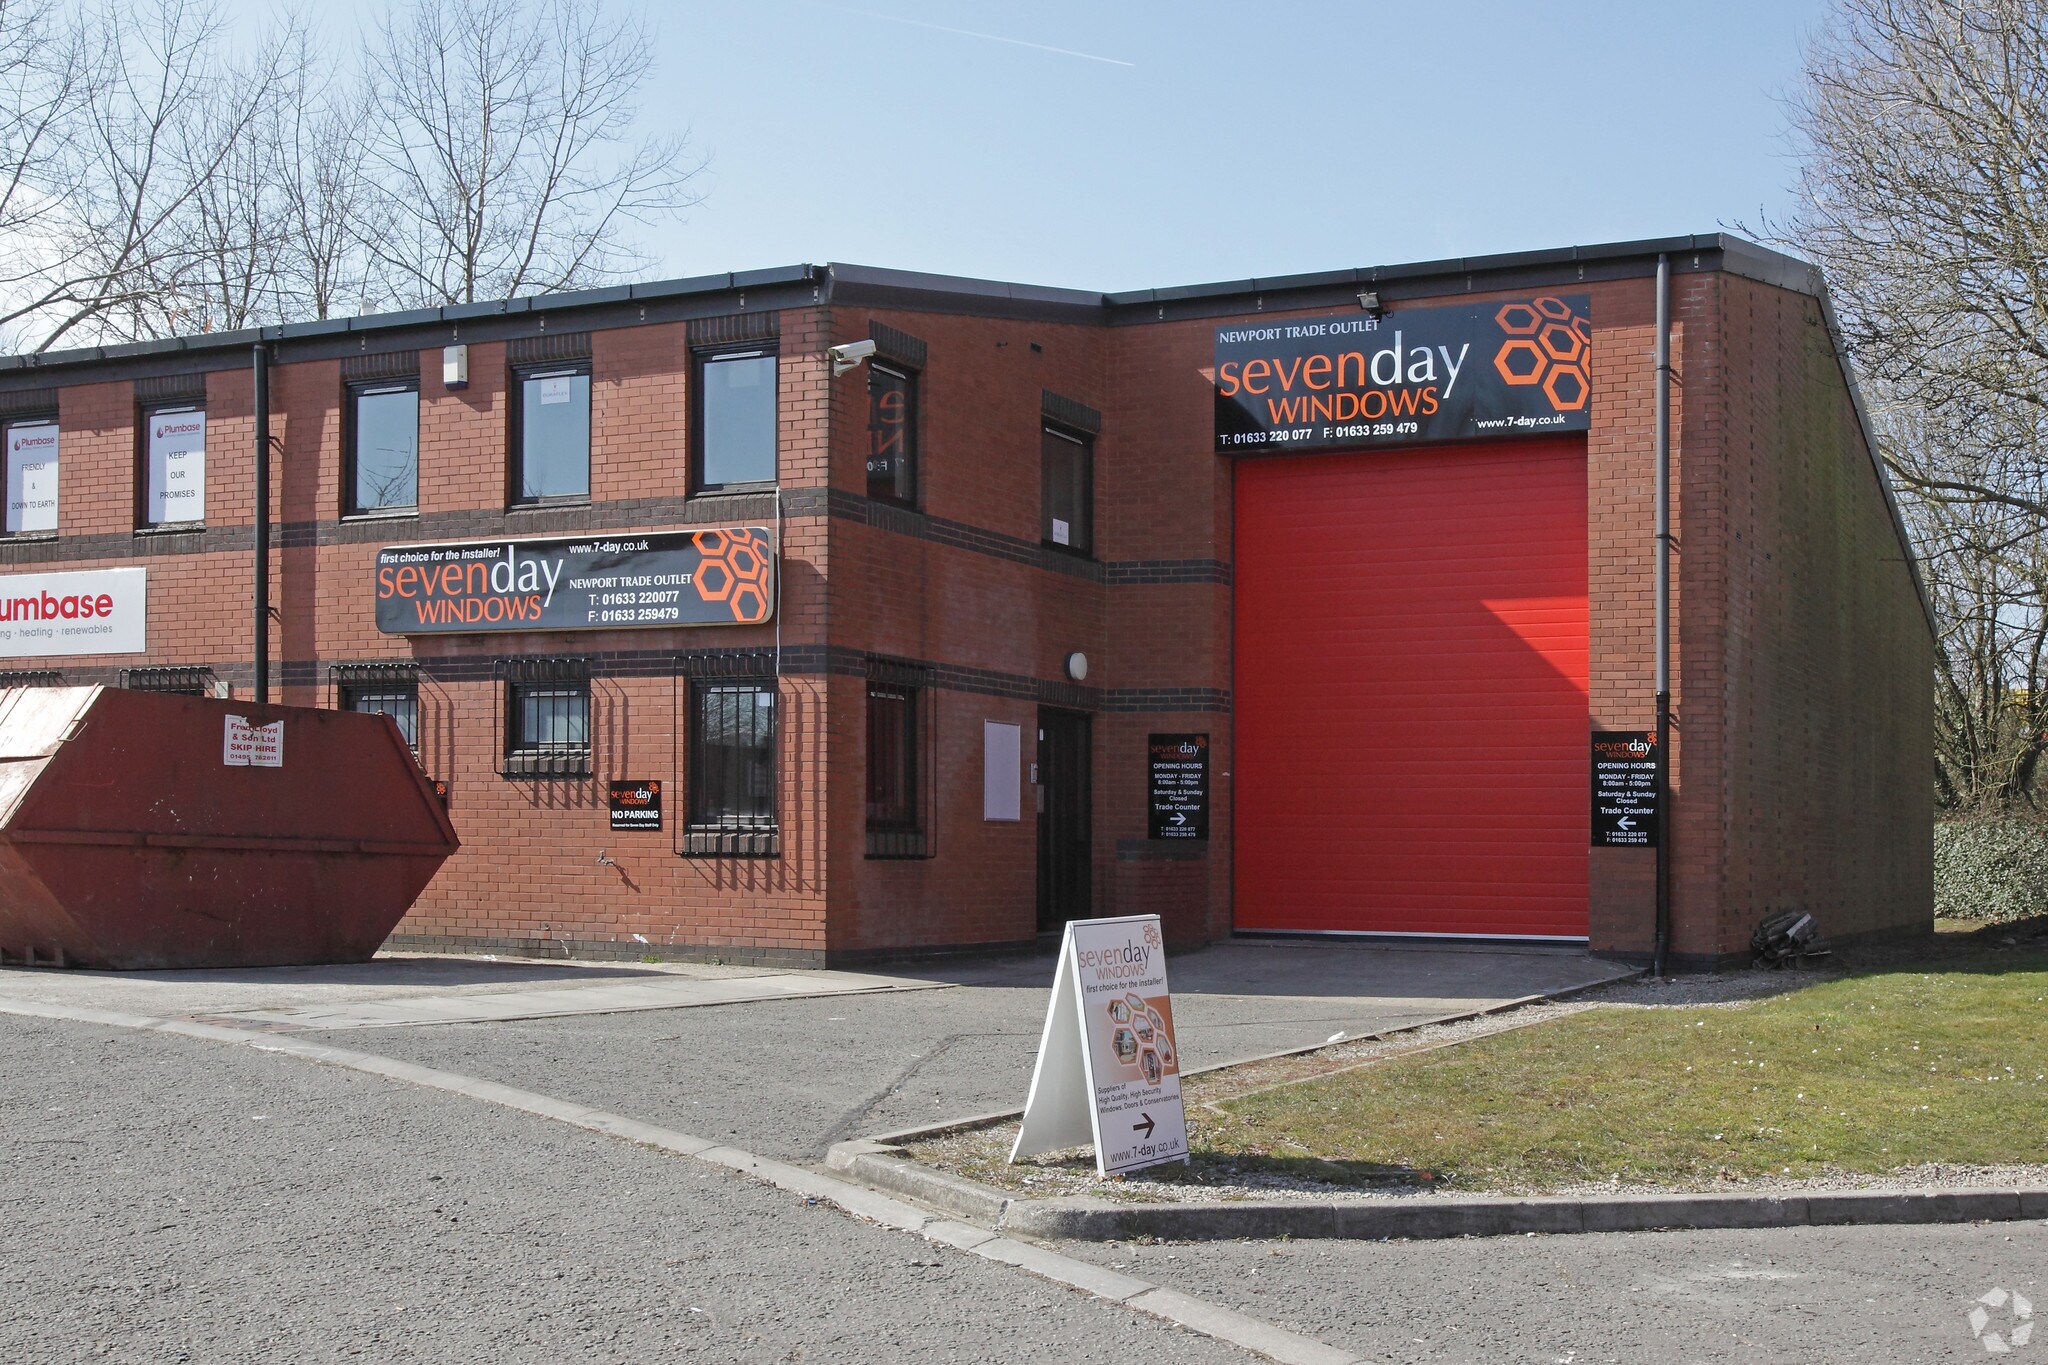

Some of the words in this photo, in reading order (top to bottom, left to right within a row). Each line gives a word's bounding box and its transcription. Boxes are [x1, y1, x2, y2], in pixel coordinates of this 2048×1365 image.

[1220, 328, 1282, 344] NEWPORT
[1285, 324, 1326, 338] TRADE
[1329, 320, 1380, 334] OUTLET
[1268, 386, 1438, 425] WINDOWS
[1477, 414, 1566, 428] www.7-day.co.uk
[164, 423, 201, 434] Plumbase
[1220, 434, 1230, 444] T:
[1234, 433, 1266, 444] 01633
[1269, 430, 1289, 442] 220
[1292, 428, 1313, 440] 077
[1323, 426, 1334, 438] F:
[1336, 424, 1370, 438] 01633
[1372, 423, 1394, 436] 259
[1396, 422, 1418, 434] 479
[22, 437, 54, 446] Plumbase
[168, 450, 188, 460] KEEP
[22, 463, 45, 472] FRIENDLY
[170, 470, 186, 479] OUR
[160, 490, 195, 499] PROMISES
[38, 500, 55, 508] EARTH
[569, 540, 649, 554] www.7-day.co.uk
[380, 553, 398, 564] first
[400, 550, 429, 563] choice
[431, 550, 444, 561] for
[446, 550, 459, 560] the
[461, 548, 500, 559] installer!
[570, 577, 617, 589] NEWPORT
[620, 576, 651, 587] TRADE
[654, 574, 692, 585] OUTLET
[589, 594, 599, 605] T:
[602, 593, 636, 605] 01633
[639, 591, 679, 603] 220077
[416, 594, 542, 624] WINDOWS
[588, 610, 598, 622] F:
[602, 610, 635, 621] 01633
[638, 608, 679, 620] 259479
[20, 628, 53, 638] heating
[62, 625, 113, 636] renewables
[612, 810, 623, 818] NO
[624, 810, 658, 818] PARKING
[1096, 964, 1145, 980] WINDOWS
[1086, 985, 1098, 993] first
[1100, 983, 1118, 992] choice
[1128, 980, 1138, 988] the
[1138, 977, 1164, 987] installer!
[1098, 1084, 1120, 1095] Suppliers
[1099, 1095, 1110, 1105] High
[1130, 1090, 1141, 1099] High
[1142, 1087, 1161, 1096] Security
[1124, 1101, 1138, 1109] Doors
[1144, 1094, 1180, 1105] Conservatories
[1110, 1137, 1180, 1163] www.7-day.co.uk
